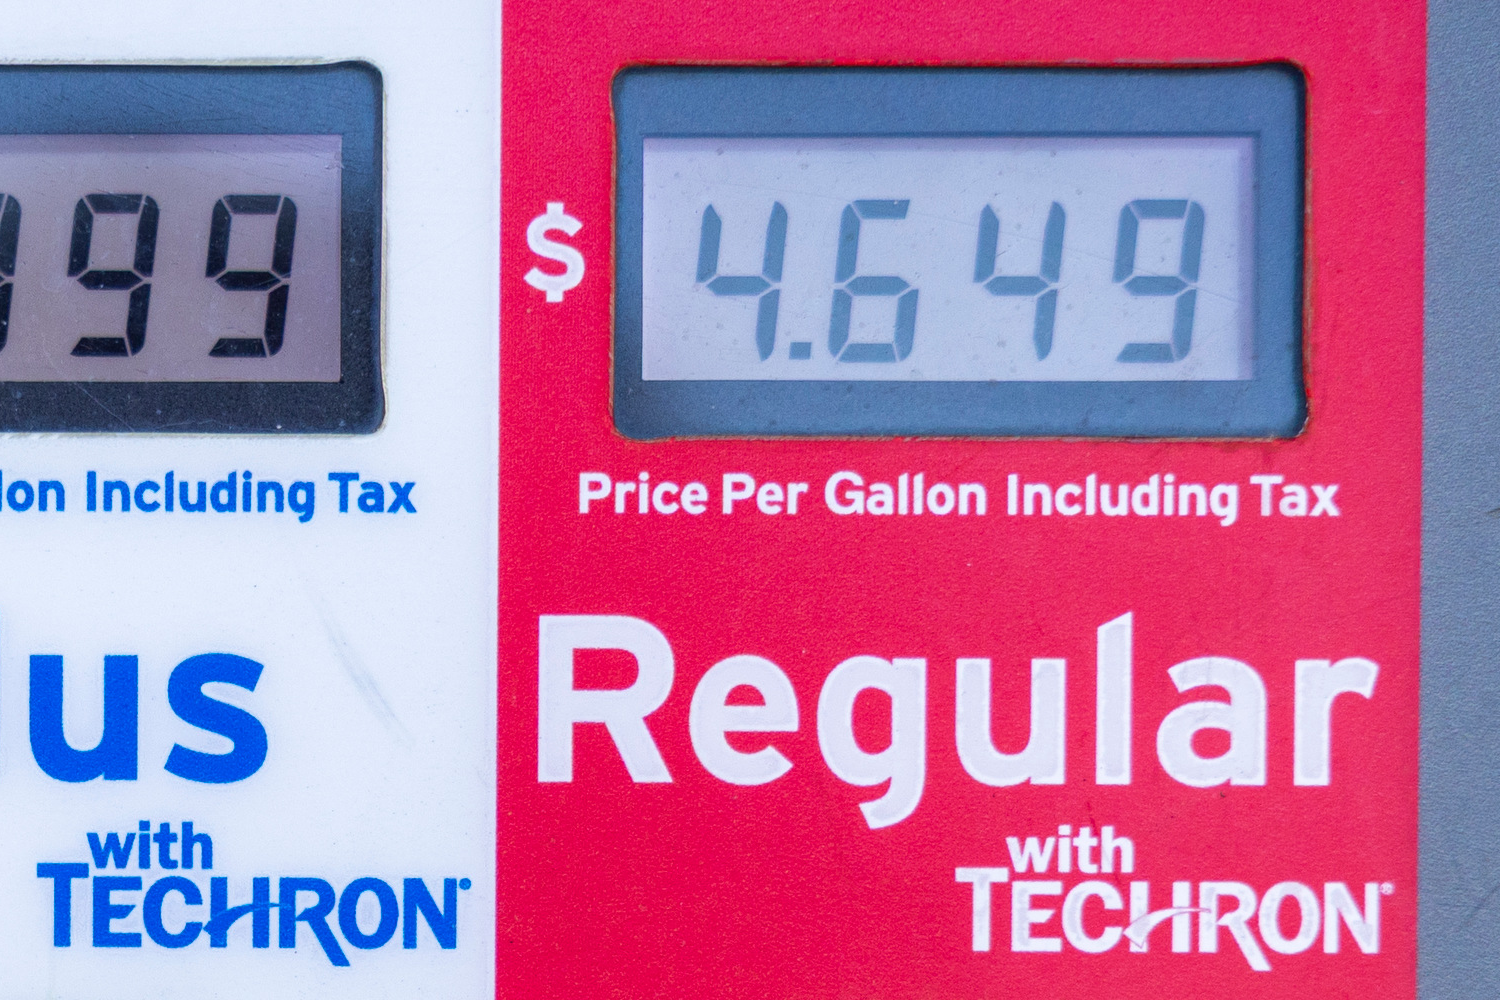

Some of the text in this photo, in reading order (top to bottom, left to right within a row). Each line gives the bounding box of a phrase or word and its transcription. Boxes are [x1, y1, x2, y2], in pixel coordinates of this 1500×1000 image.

[523, 202, 584, 302] $
[696, 200, 1205, 364] 4.649
[86, 470, 314, 523] Including
[327, 473, 417, 514] Tax
[579, 472, 1339, 526] Price Per Gallon Including Tax
[537, 611, 1380, 829] Regular
[86, 821, 213, 870] with
[1005, 825, 1134, 873] with
